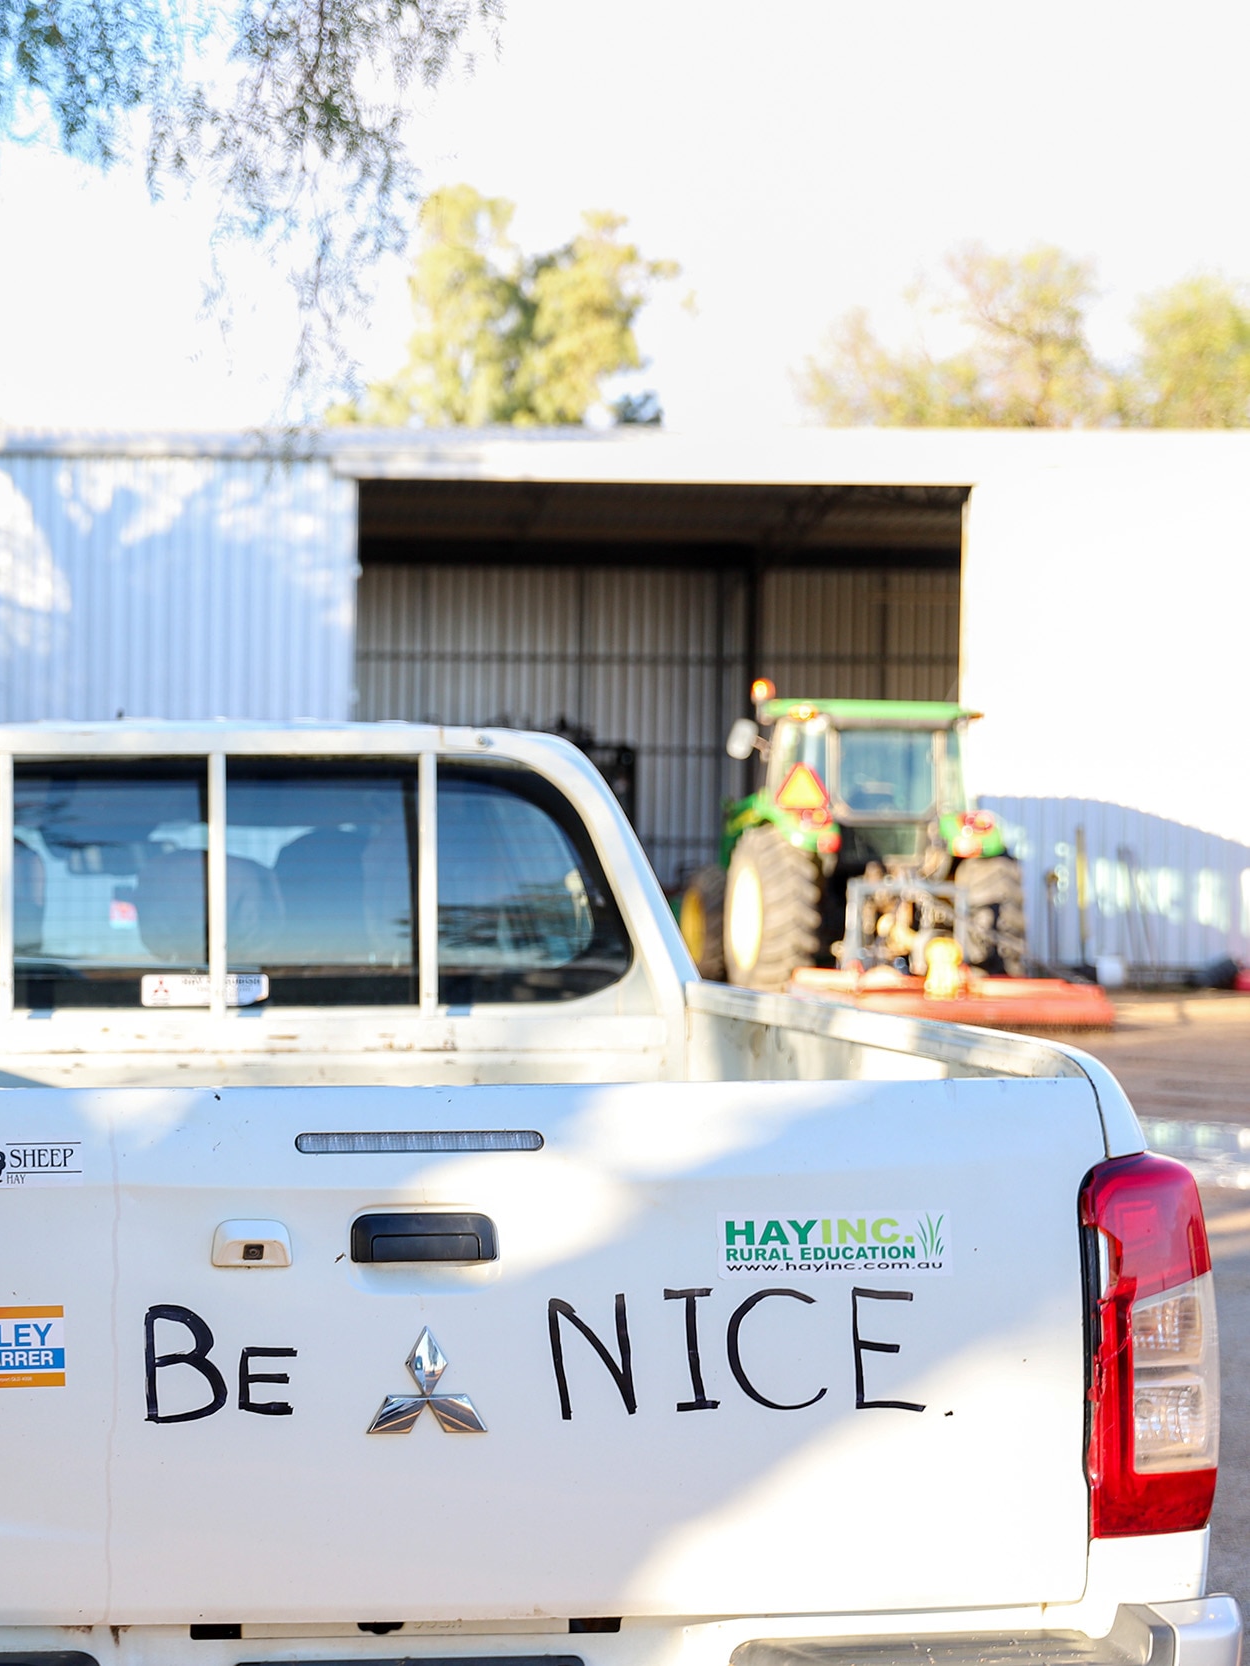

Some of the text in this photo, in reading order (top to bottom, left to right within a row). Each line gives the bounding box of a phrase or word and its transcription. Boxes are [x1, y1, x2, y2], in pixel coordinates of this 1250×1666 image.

[9, 1148, 74, 1169] SHEEP
[6, 1174, 26, 1185] HAY
[726, 1245, 916, 1262] RURAL EDUCATION
[726, 1260, 943, 1273] www.hayinc.com.au
